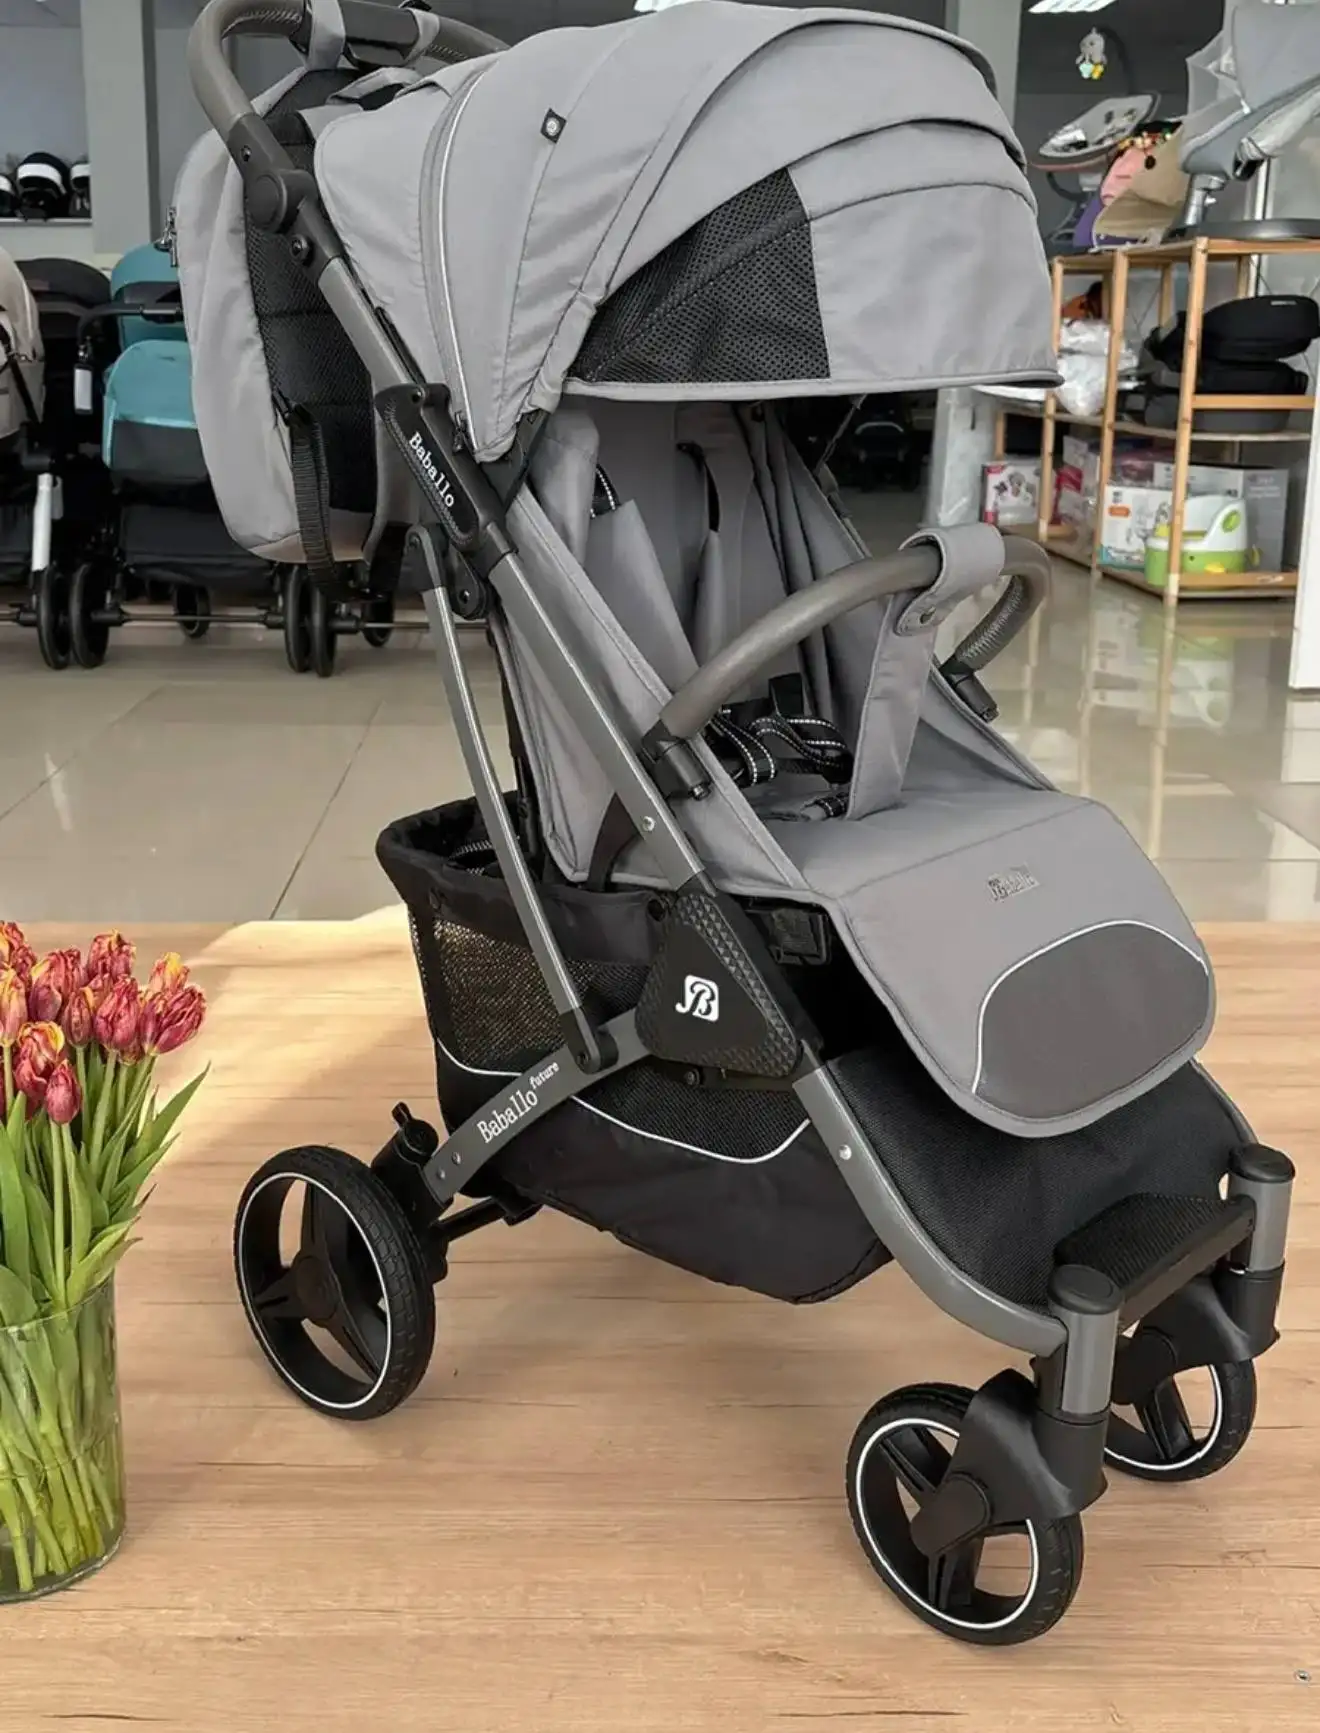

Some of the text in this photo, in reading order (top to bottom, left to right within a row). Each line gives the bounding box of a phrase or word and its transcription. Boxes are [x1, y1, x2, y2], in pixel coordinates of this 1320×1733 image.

[409, 431, 454, 507] Baballo
[476, 1062, 560, 1143] Baballo future
